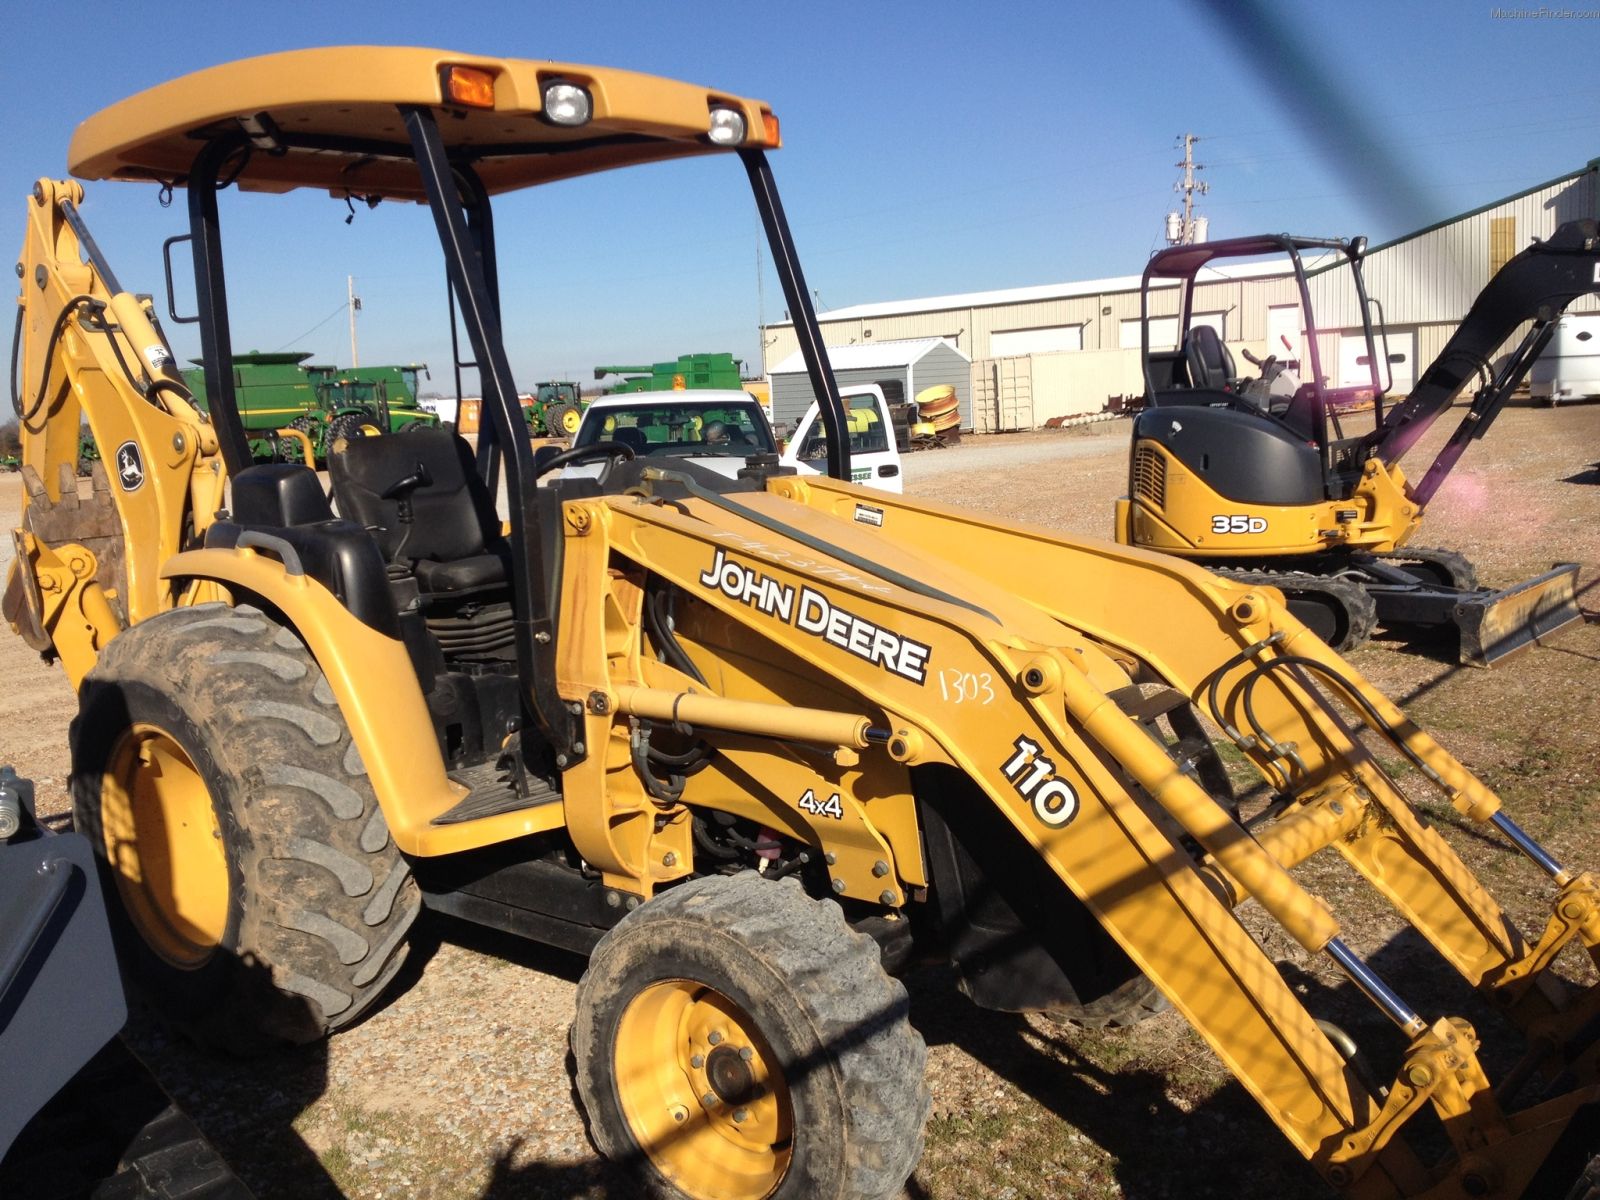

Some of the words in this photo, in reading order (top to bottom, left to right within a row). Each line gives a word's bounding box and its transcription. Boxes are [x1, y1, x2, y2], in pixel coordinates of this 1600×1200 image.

[1212, 515, 1268, 534] 35D
[701, 548, 796, 622] JOHN
[798, 590, 930, 684] DEERE
[938, 668, 995, 706] 1303
[1001, 736, 1078, 827] 110
